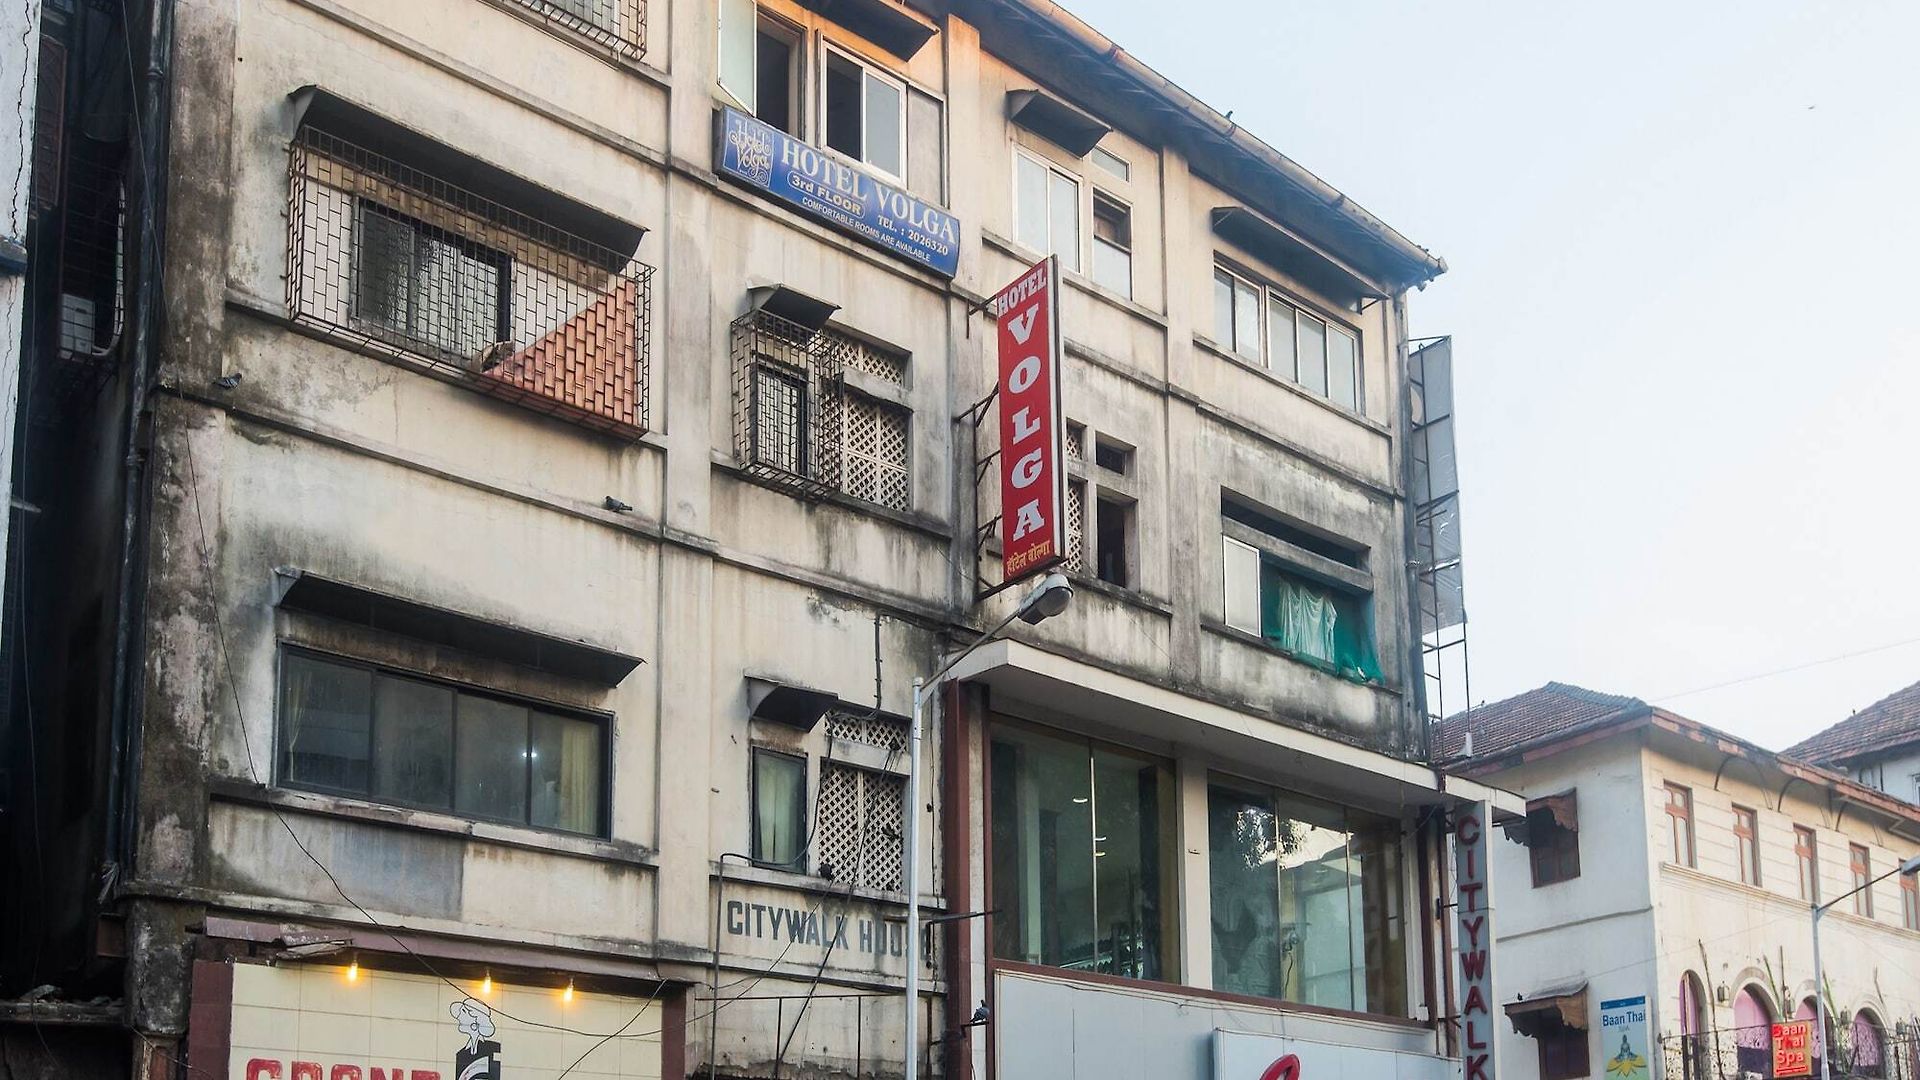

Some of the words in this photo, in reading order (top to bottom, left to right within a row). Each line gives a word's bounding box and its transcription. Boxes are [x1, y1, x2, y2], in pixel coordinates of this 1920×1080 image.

[781, 137, 867, 202] HOTEL
[874, 183, 956, 244] VOLGA
[792, 175, 814, 193] 3rd
[817, 186, 861, 215] FLOOR
[802, 196, 855, 227] COMFORTABLE
[855, 219, 880, 238] ROOMS
[880, 233, 895, 246] ARE
[895, 240, 931, 262] AVAILABLE
[908, 229, 948, 256] 2026320
[997, 266, 1047, 318] HOTEL
[1008, 302, 1045, 542] VOLGA
[727, 900, 849, 950] CITYWALK
[1457, 815, 1488, 1080] CITYWALK
[1602, 1014, 1625, 1027] Baan
[1626, 1009, 1646, 1023] Thai
[1772, 1024, 1807, 1037] Baan
[1776, 1050, 1804, 1067] Spa
